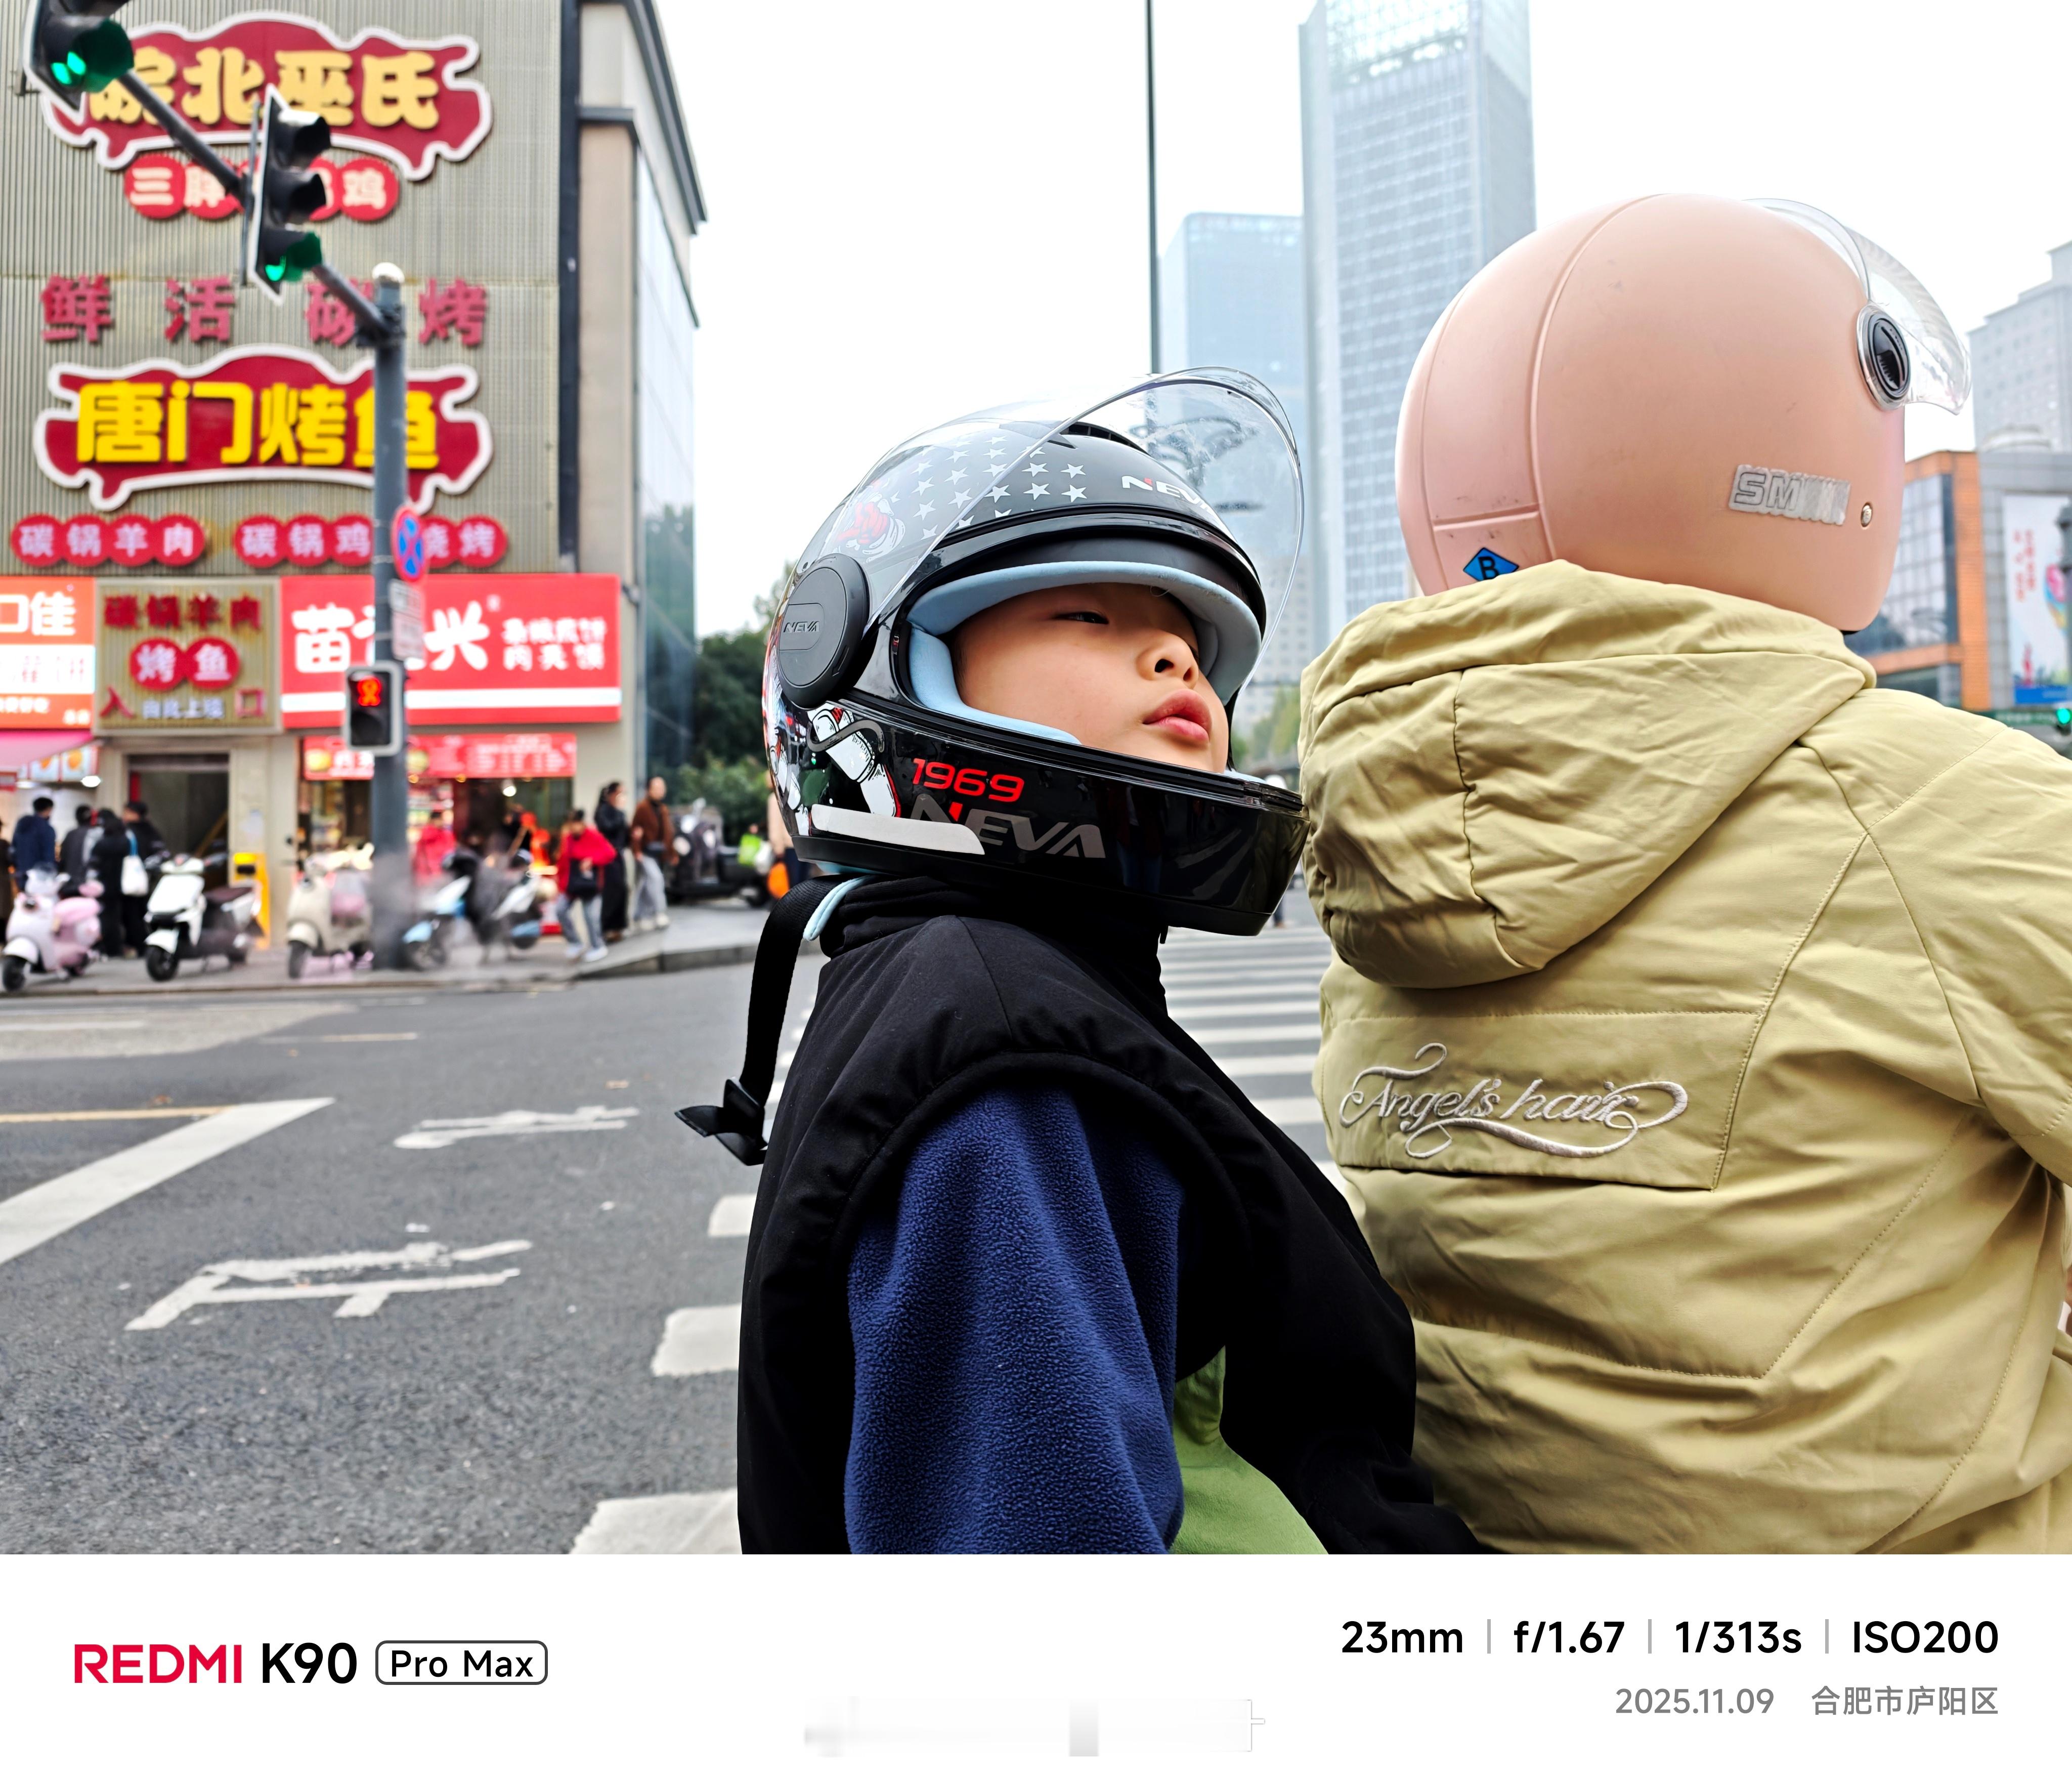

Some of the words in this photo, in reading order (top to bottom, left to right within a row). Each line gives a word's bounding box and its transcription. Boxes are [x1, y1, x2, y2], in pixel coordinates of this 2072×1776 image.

[77, 379, 440, 469] 唐门烤鱼
[19, 523, 194, 558] 碳锅羊肉
[1478, 556, 1500, 581] B
[291, 601, 490, 673] 苗兴
[783, 620, 820, 633] NEVA
[135, 643, 232, 683] 烤鱼
[912, 757, 1025, 803] 1969
[910, 793, 1107, 859] NEVA
